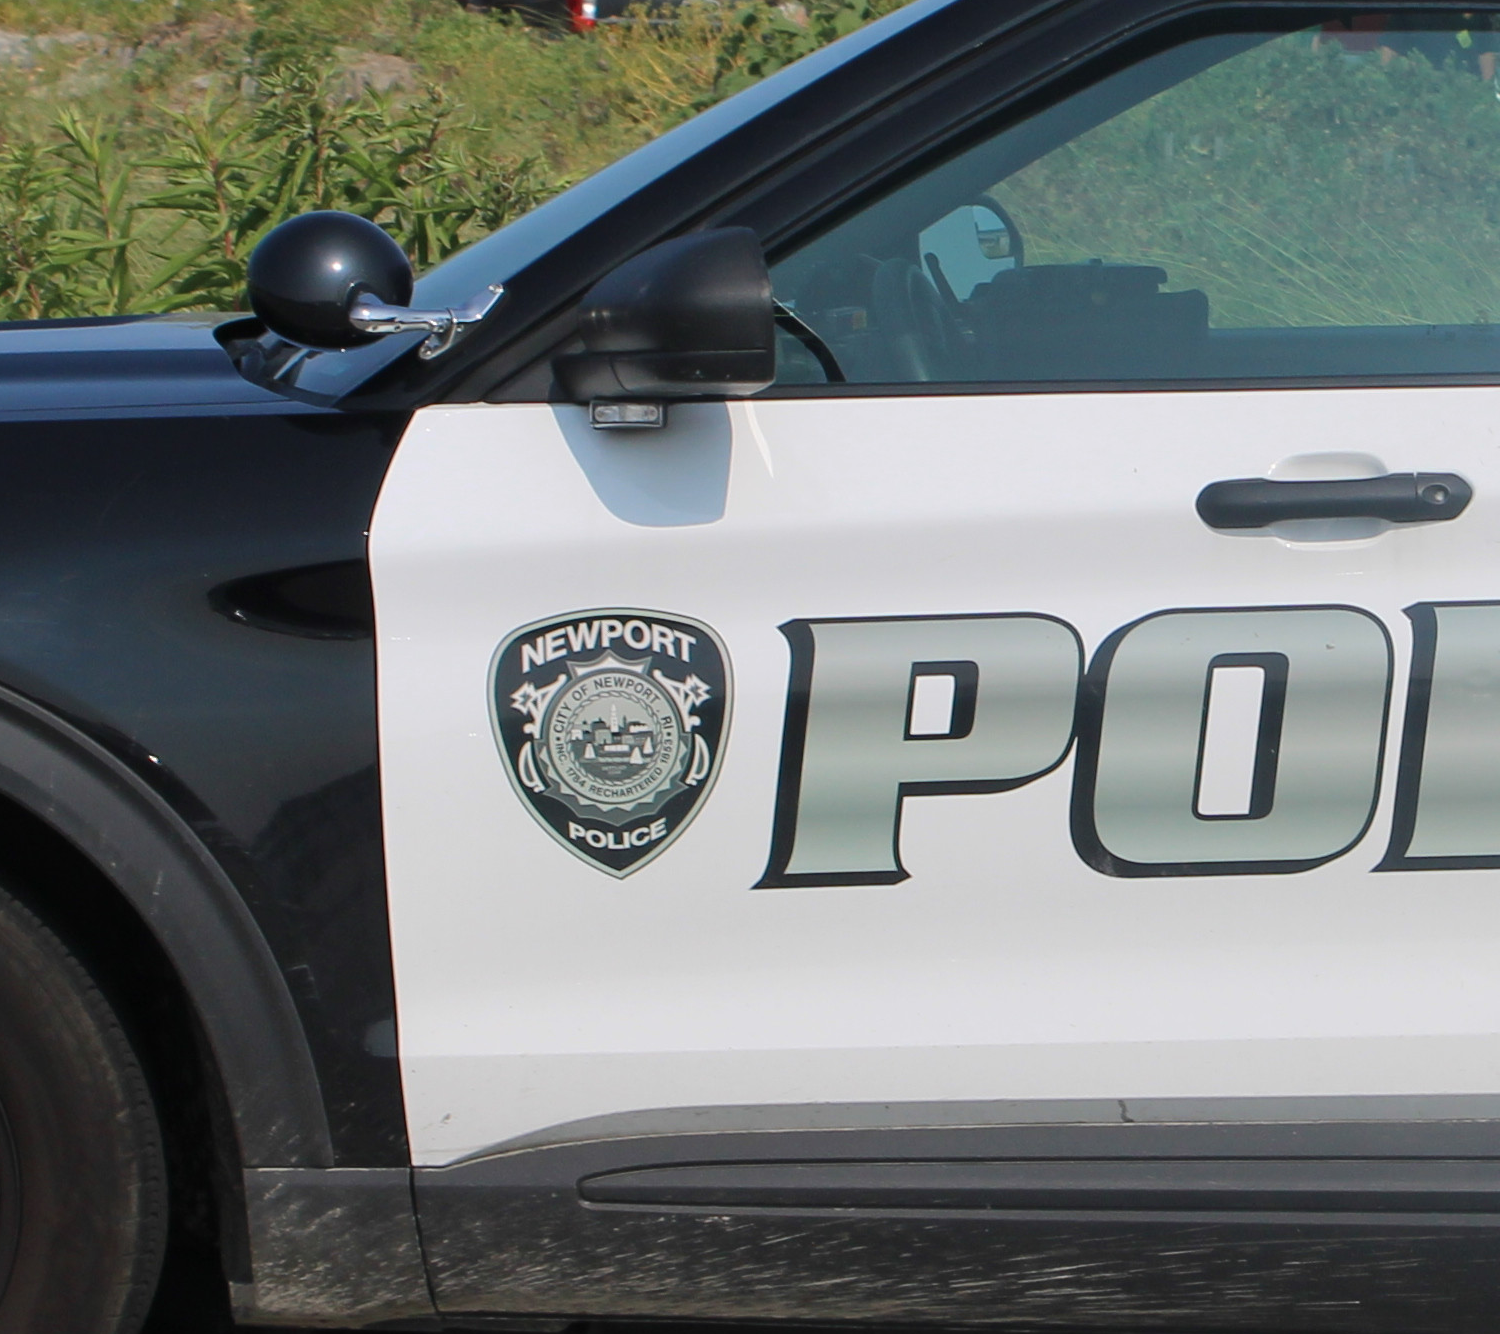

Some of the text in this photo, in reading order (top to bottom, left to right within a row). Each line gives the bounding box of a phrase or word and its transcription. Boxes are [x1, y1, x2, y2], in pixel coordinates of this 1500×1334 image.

[521, 619, 697, 674] NEWPORT
[553, 702, 573, 734] CITY
[571, 683, 589, 702] OF
[660, 715, 675, 730] RI
[565, 766, 587, 788] 1784
[587, 767, 664, 798] RECHARTERED
[568, 817, 668, 850] POLICE
